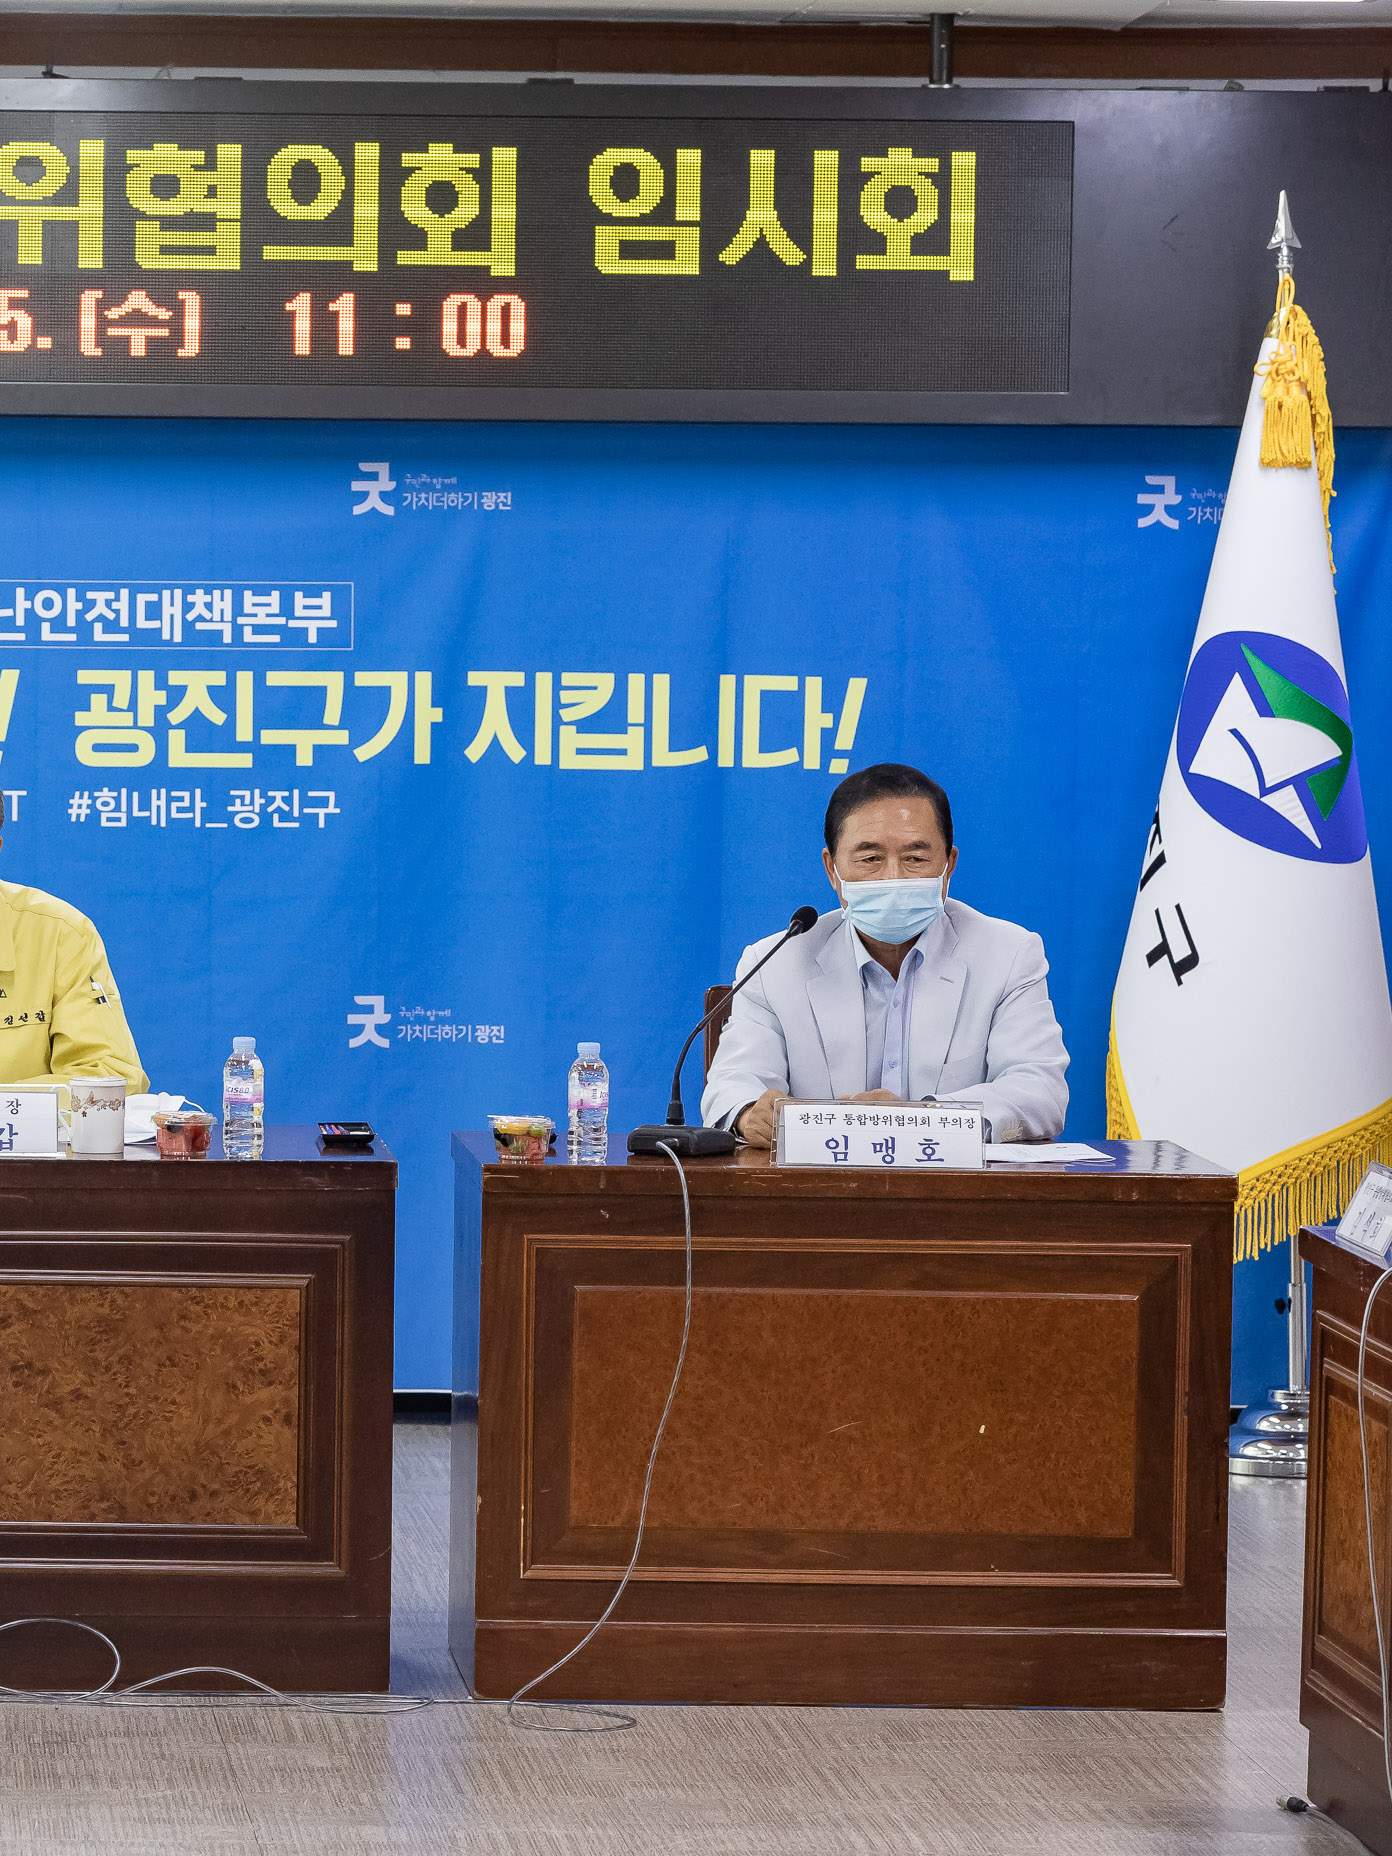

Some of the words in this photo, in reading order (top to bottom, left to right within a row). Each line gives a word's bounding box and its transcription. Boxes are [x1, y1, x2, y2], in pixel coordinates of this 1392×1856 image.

[588, 147, 977, 282] 임시회
[402, 492, 478, 510] 가치더하기
[481, 492, 512, 510] 광진
[75, 670, 442, 767] 광진구가
[465, 672, 867, 773] 지킵니다!
[67, 787, 341, 829] #힘내라_광진구
[397, 1024, 472, 1042] 가치더하기
[474, 1024, 505, 1043] 광진
[799, 1112, 837, 1126] 광진구
[843, 1113, 931, 1128] 통합방위협의회
[938, 1116, 976, 1130] 부의장
